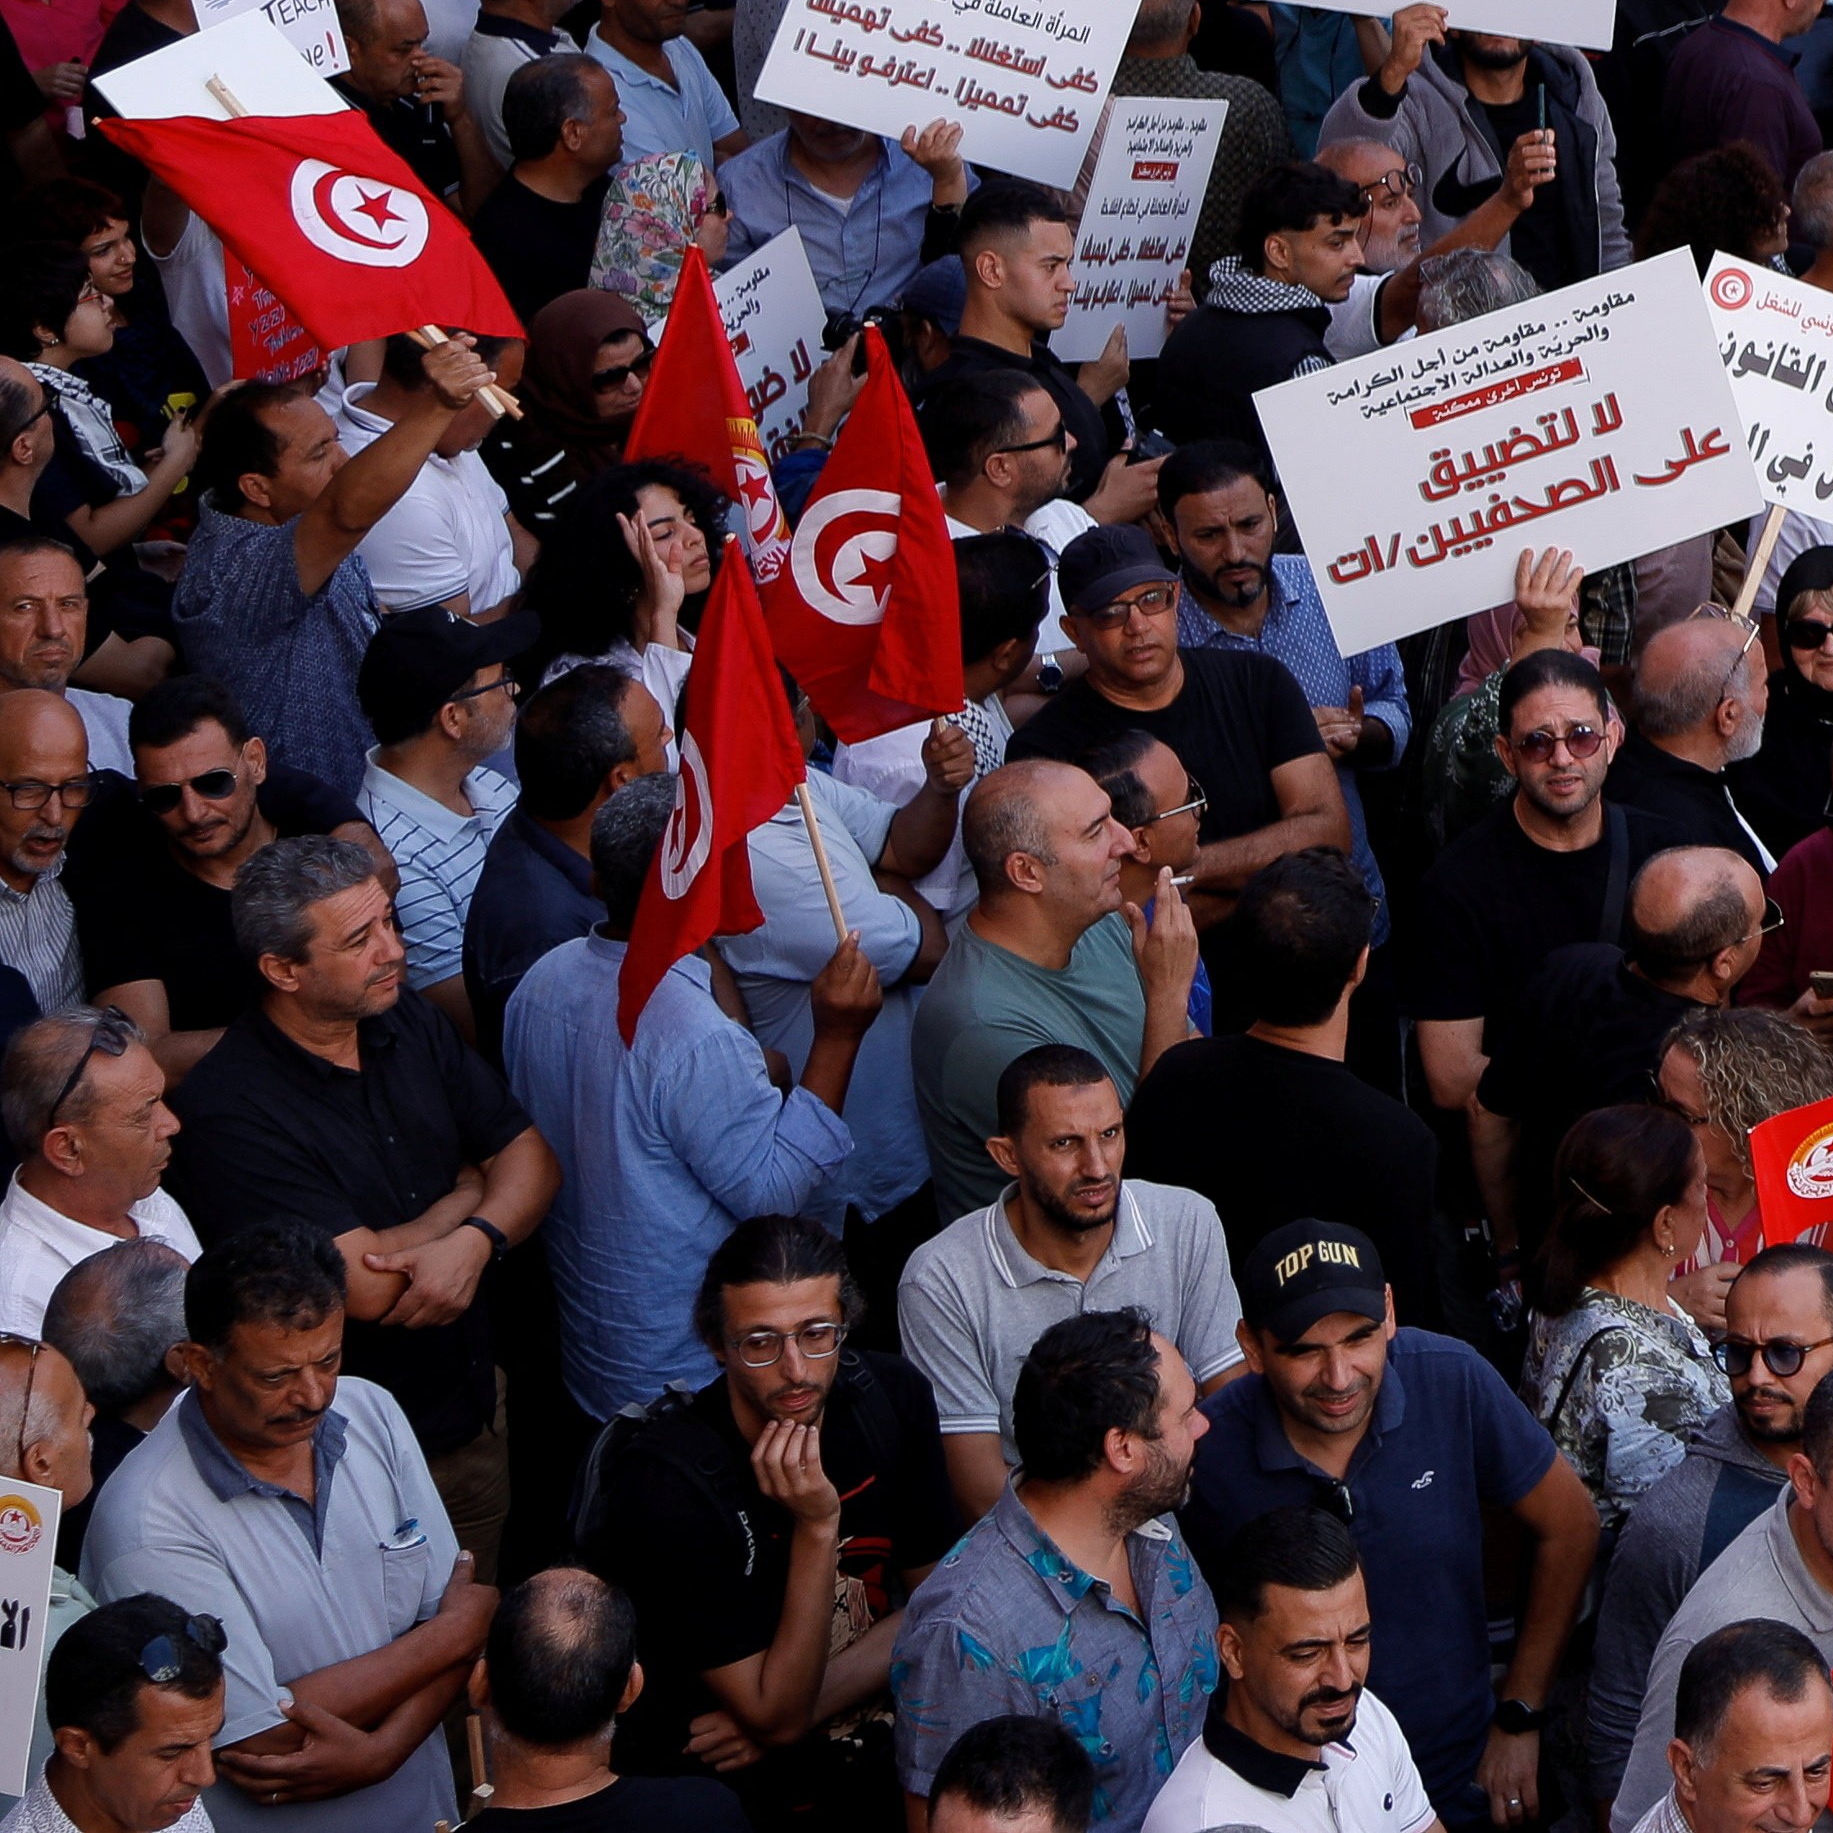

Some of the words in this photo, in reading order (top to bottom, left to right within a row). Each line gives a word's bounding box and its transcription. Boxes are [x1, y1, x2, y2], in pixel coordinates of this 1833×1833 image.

[984, 0, 1043, 30] العاملة
[1045, 11, 1091, 44] المرأة
[892, 20, 944, 48] كفى
[1044, 66, 1099, 94] كفى
[1025, 106, 1080, 134] كفى
[1755, 291, 1803, 319] للشغل
[1591, 392, 1623, 437] لا
[1418, 406, 1580, 503] لتضييق
[1632, 427, 1731, 487] على
[1326, 454, 1621, 585] الصحفيين/ات
[1275, 1244, 1315, 1287] TOP
[1317, 1240, 1361, 1270] GUN
